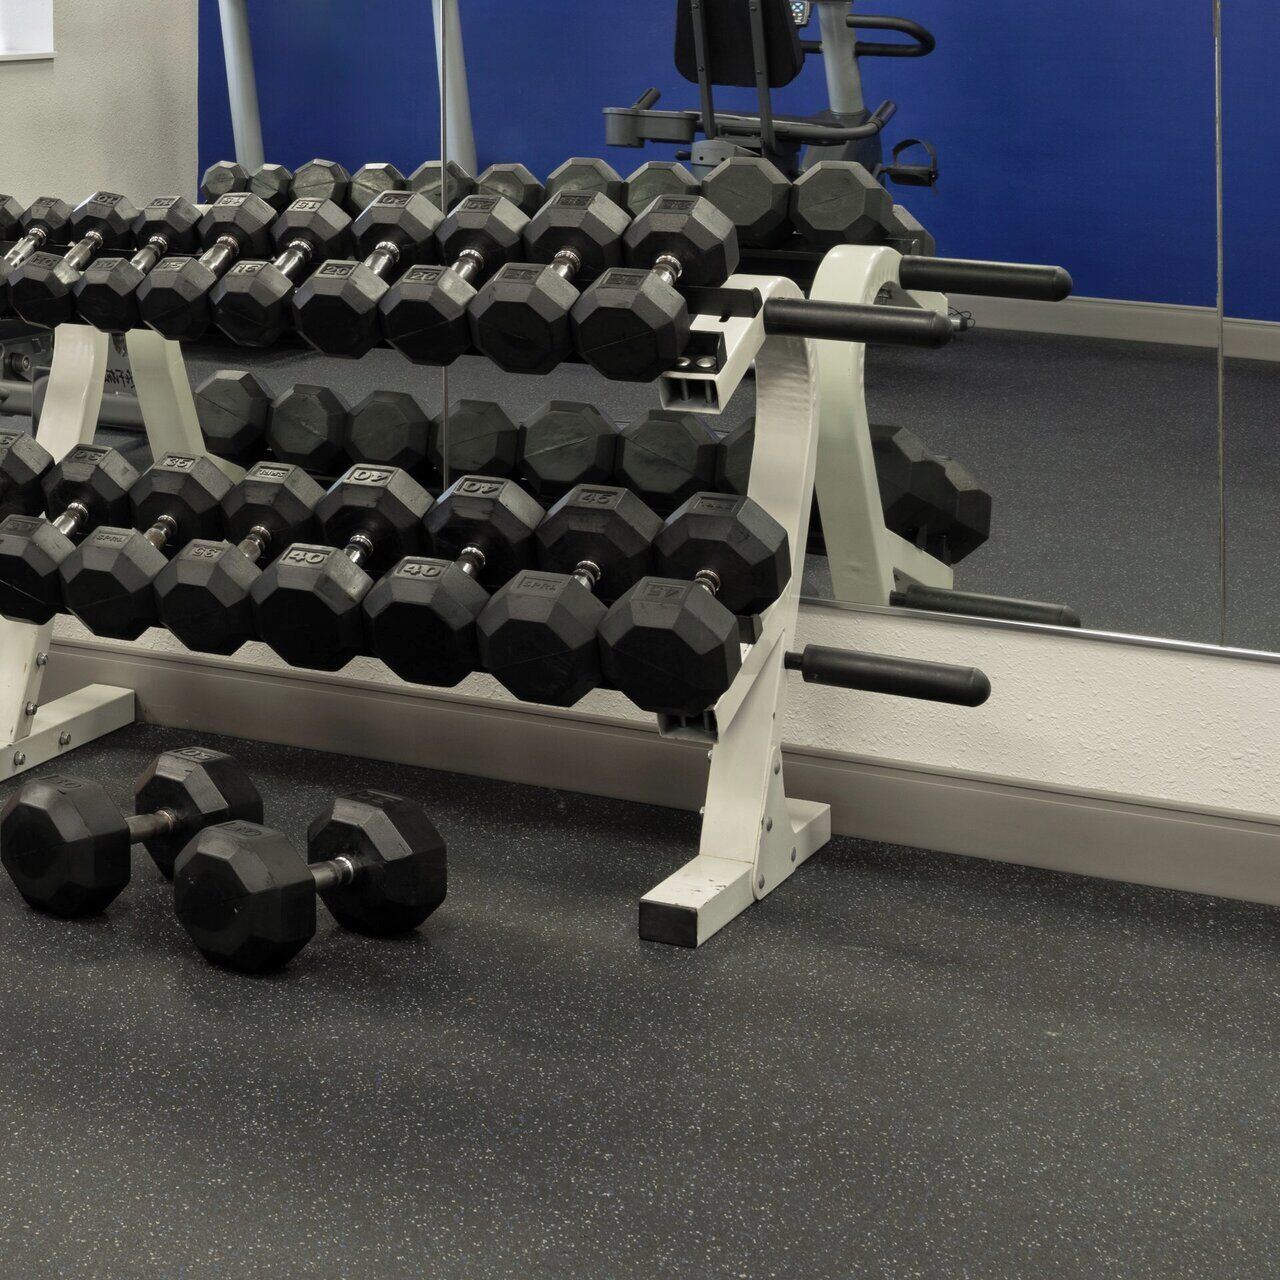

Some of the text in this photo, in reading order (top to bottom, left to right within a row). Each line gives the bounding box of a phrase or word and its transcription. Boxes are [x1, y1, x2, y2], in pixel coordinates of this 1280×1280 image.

[323, 265, 349, 276] 20
[408, 271, 437, 281] 20
[166, 456, 190, 469] 35
[354, 470, 389, 483] 40
[461, 480, 497, 494] 40
[583, 491, 611, 505] 45
[288, 550, 325, 564] 40
[401, 563, 442, 578] 40
